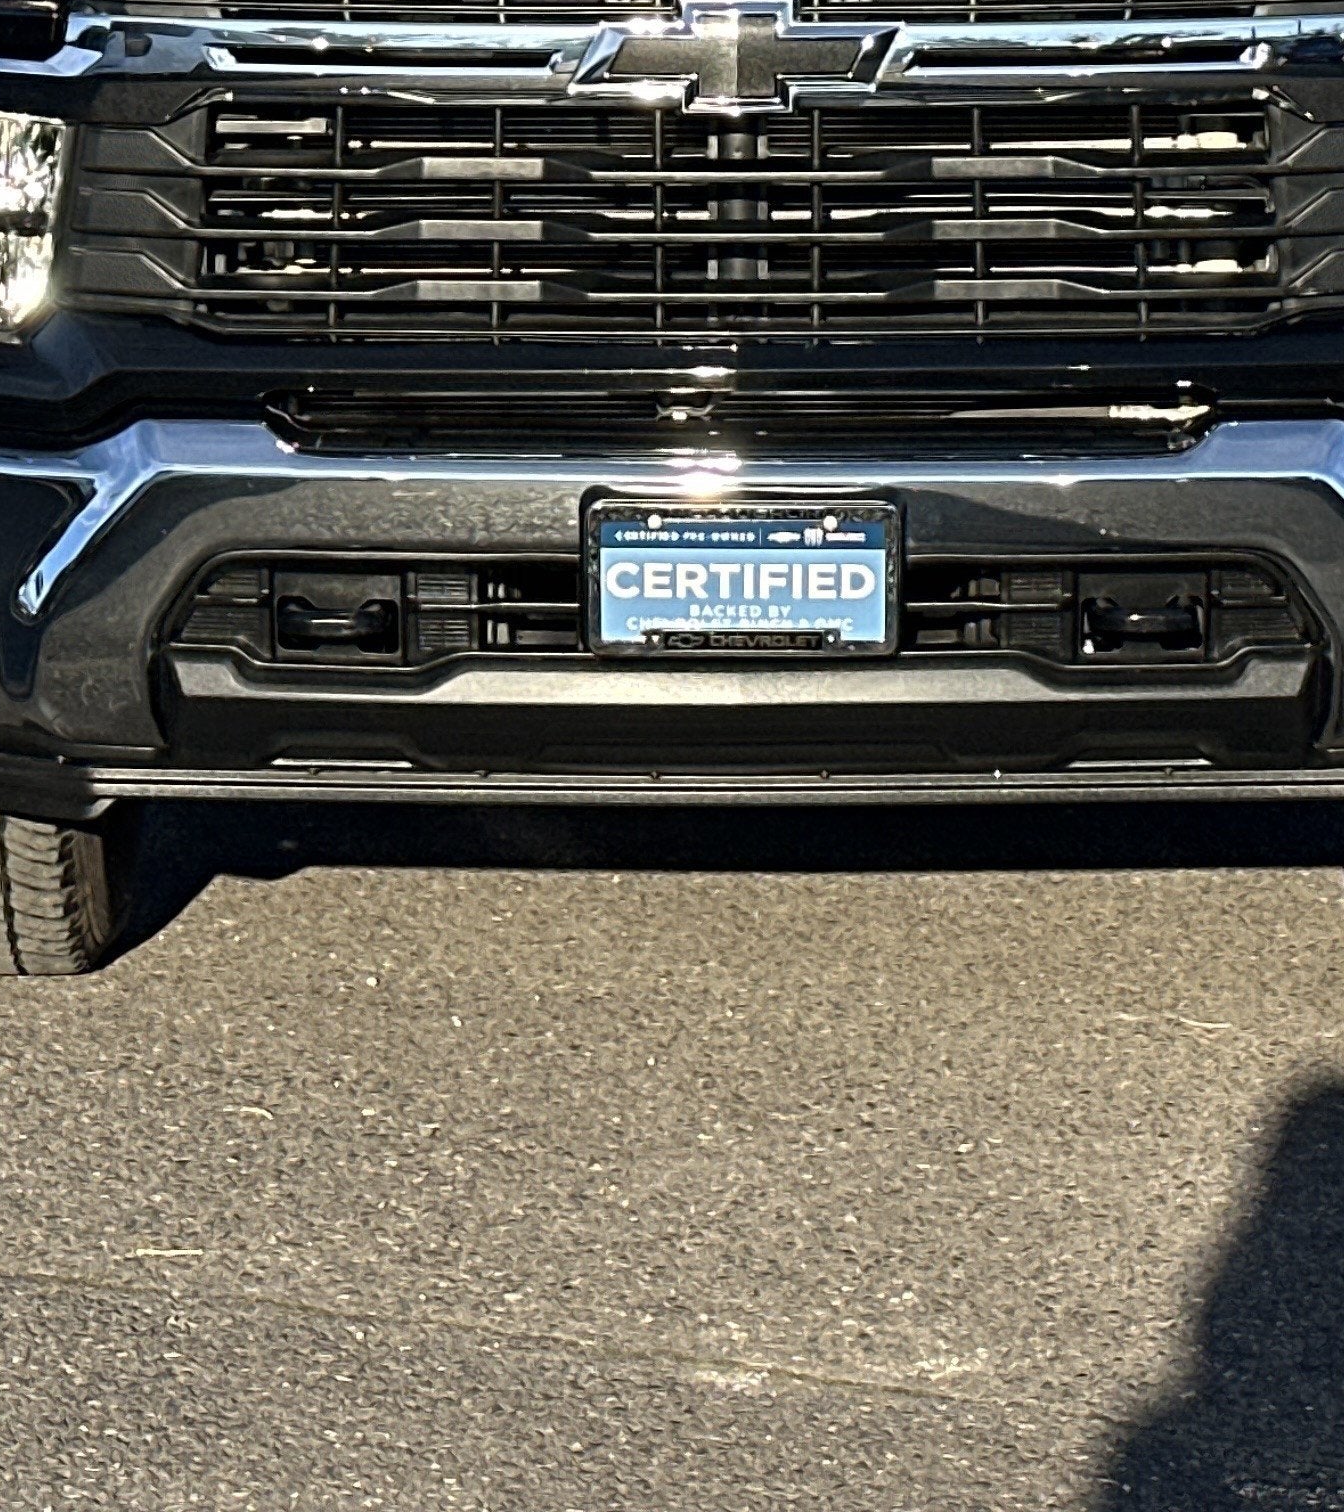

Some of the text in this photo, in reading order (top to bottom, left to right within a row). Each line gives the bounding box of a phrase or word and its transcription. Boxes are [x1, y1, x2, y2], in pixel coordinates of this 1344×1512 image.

[606, 562, 876, 599] CERTIFIED
[689, 604, 792, 618] BACKED BY
[709, 634, 819, 648] CHEVROLET
